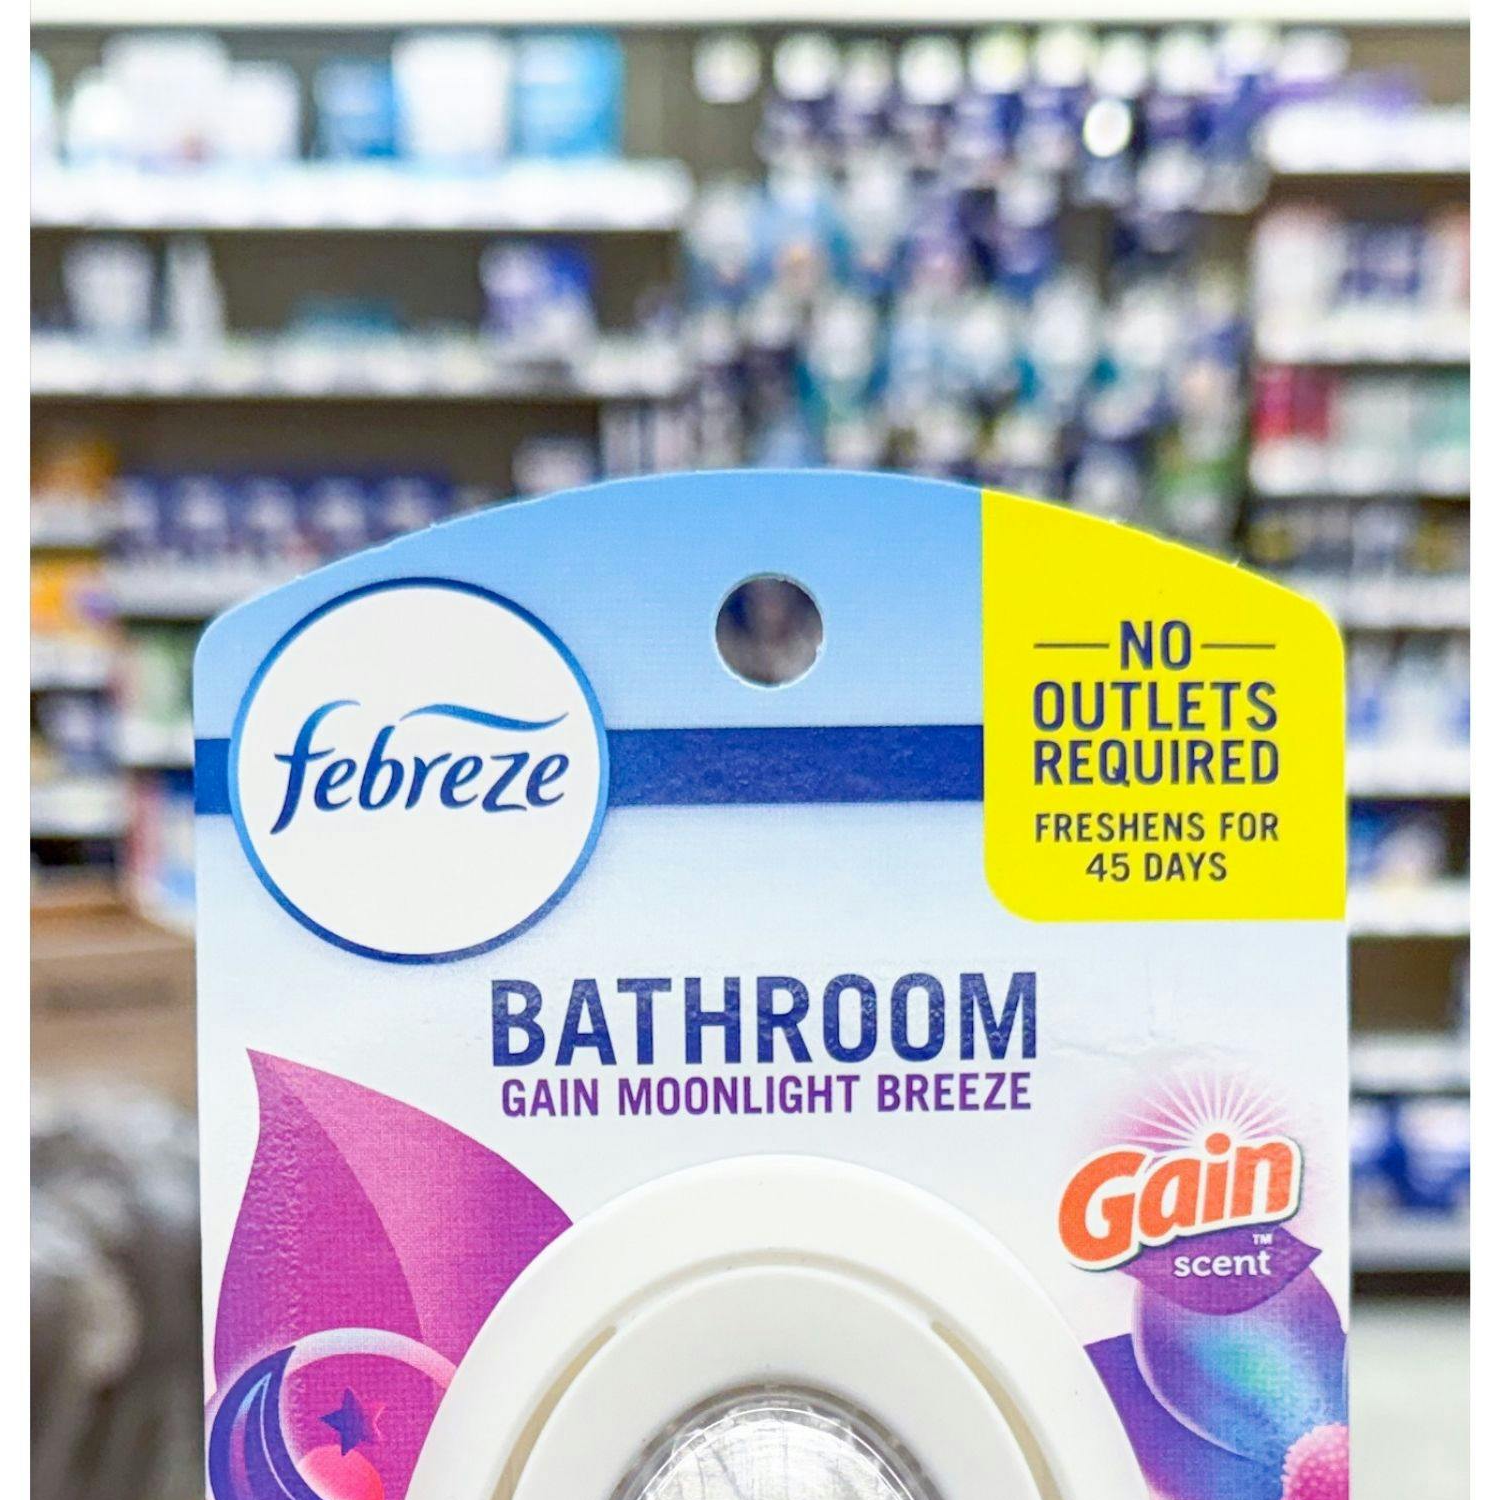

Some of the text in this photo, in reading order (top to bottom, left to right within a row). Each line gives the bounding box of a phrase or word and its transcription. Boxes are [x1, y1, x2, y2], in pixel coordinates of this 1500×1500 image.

[1119, 620, 1192, 671] NO
[1033, 680, 1278, 732] OUTLETS
[269, 698, 570, 835] febreze
[1033, 739, 1280, 787] REQUIRED
[1035, 812, 1280, 842] FRESHENS FOR
[1086, 851, 1228, 883] 45 DAYS
[491, 971, 1038, 1067] BATHROOM
[501, 1071, 1032, 1118] GAIN MOONLIGHT BREEZE
[1058, 1132, 1294, 1262] Gain
[1173, 1250, 1272, 1277] scent
